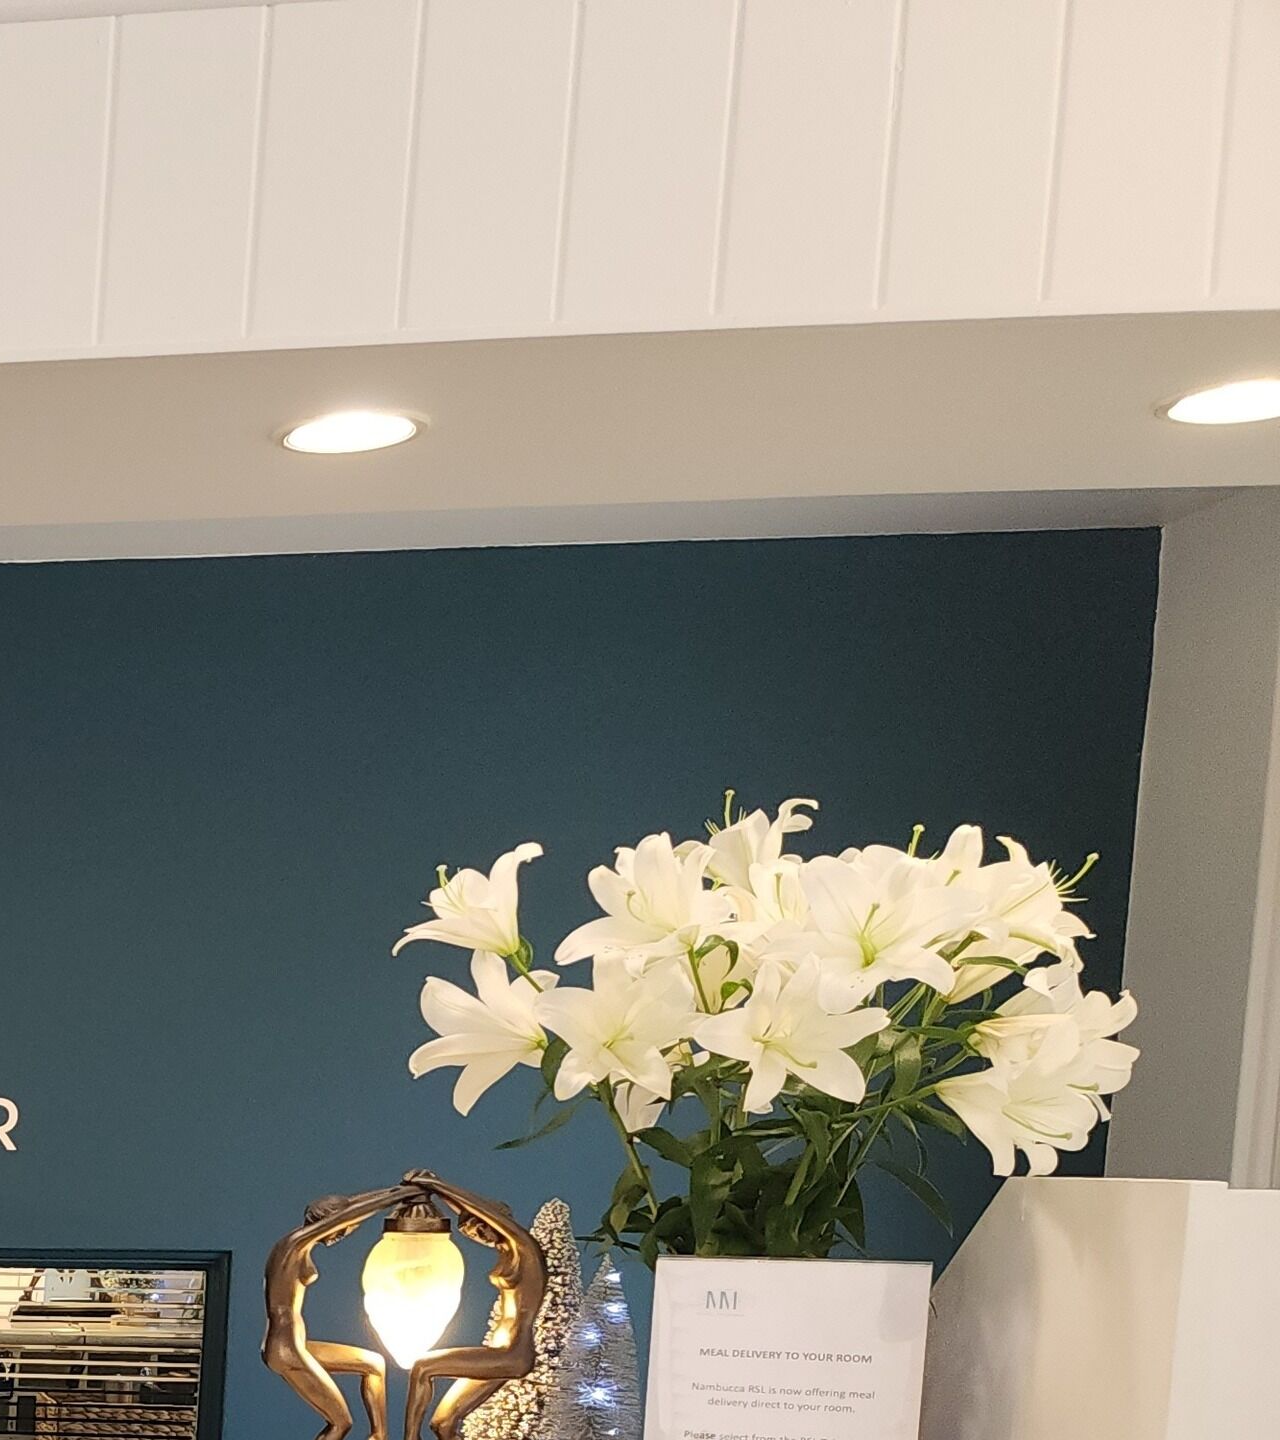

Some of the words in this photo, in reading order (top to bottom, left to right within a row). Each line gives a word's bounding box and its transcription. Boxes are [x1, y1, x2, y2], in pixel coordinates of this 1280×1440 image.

[699, 1348, 730, 1358] MEAL
[731, 1349, 783, 1361] DELIVERY
[785, 1351, 800, 1361] TO
[802, 1352, 834, 1363] YOUR
[835, 1353, 873, 1364] ROOM
[691, 1382, 746, 1393] Nambucca
[748, 1384, 767, 1395] RSL
[768, 1385, 778, 1395] is
[779, 1388, 803, 1396] now
[804, 1387, 846, 1400] offering
[848, 1390, 876, 1400] meal
[707, 1397, 748, 1409] delivery
[750, 1398, 781, 1409] direct
[783, 1401, 795, 1410] to
[796, 1402, 822, 1413] your
[823, 1404, 856, 1414] room.
[683, 1429, 717, 1440] Please
